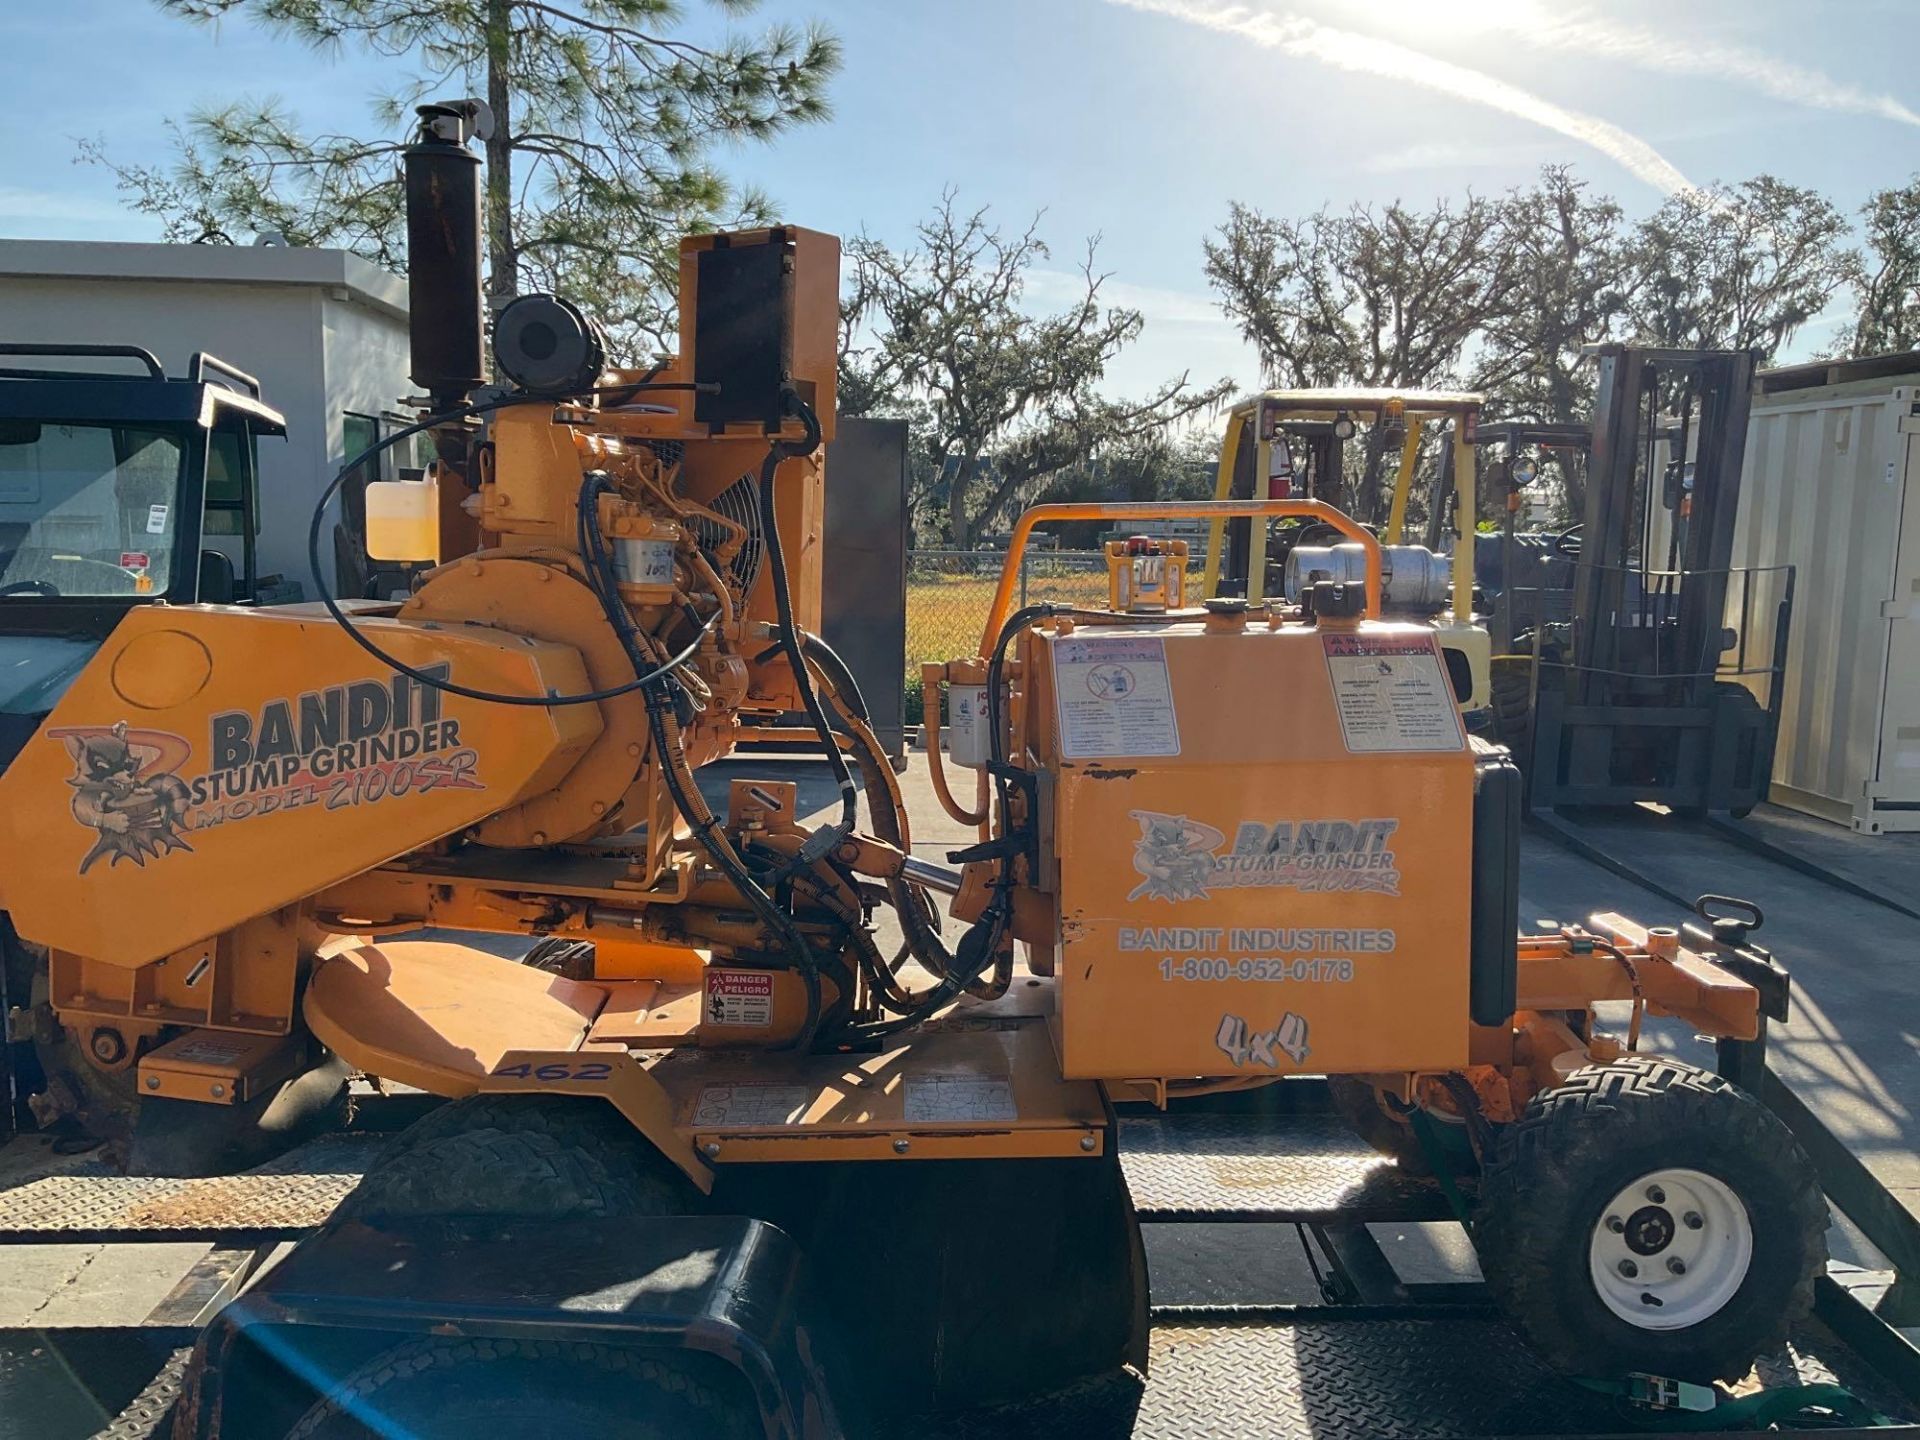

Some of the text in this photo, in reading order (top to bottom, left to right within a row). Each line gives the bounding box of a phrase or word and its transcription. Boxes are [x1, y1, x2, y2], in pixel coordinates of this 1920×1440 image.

[212, 663, 448, 772] BANDIT
[191, 719, 462, 806] STUMP GRINDER
[194, 751, 477, 829] MODEL 2100SR
[1234, 820, 1398, 855] BANDIT
[1215, 853, 1393, 873] STUMP GRINDER
[1119, 928, 1396, 952] BANDIT INDUSTRIES
[725, 975, 768, 984] DANGER
[1160, 958, 1354, 981] 1-800-952-0178
[725, 985, 769, 994] PELIGRO
[1216, 1011, 1310, 1068] 4x4
[491, 1063, 612, 1081] 462
